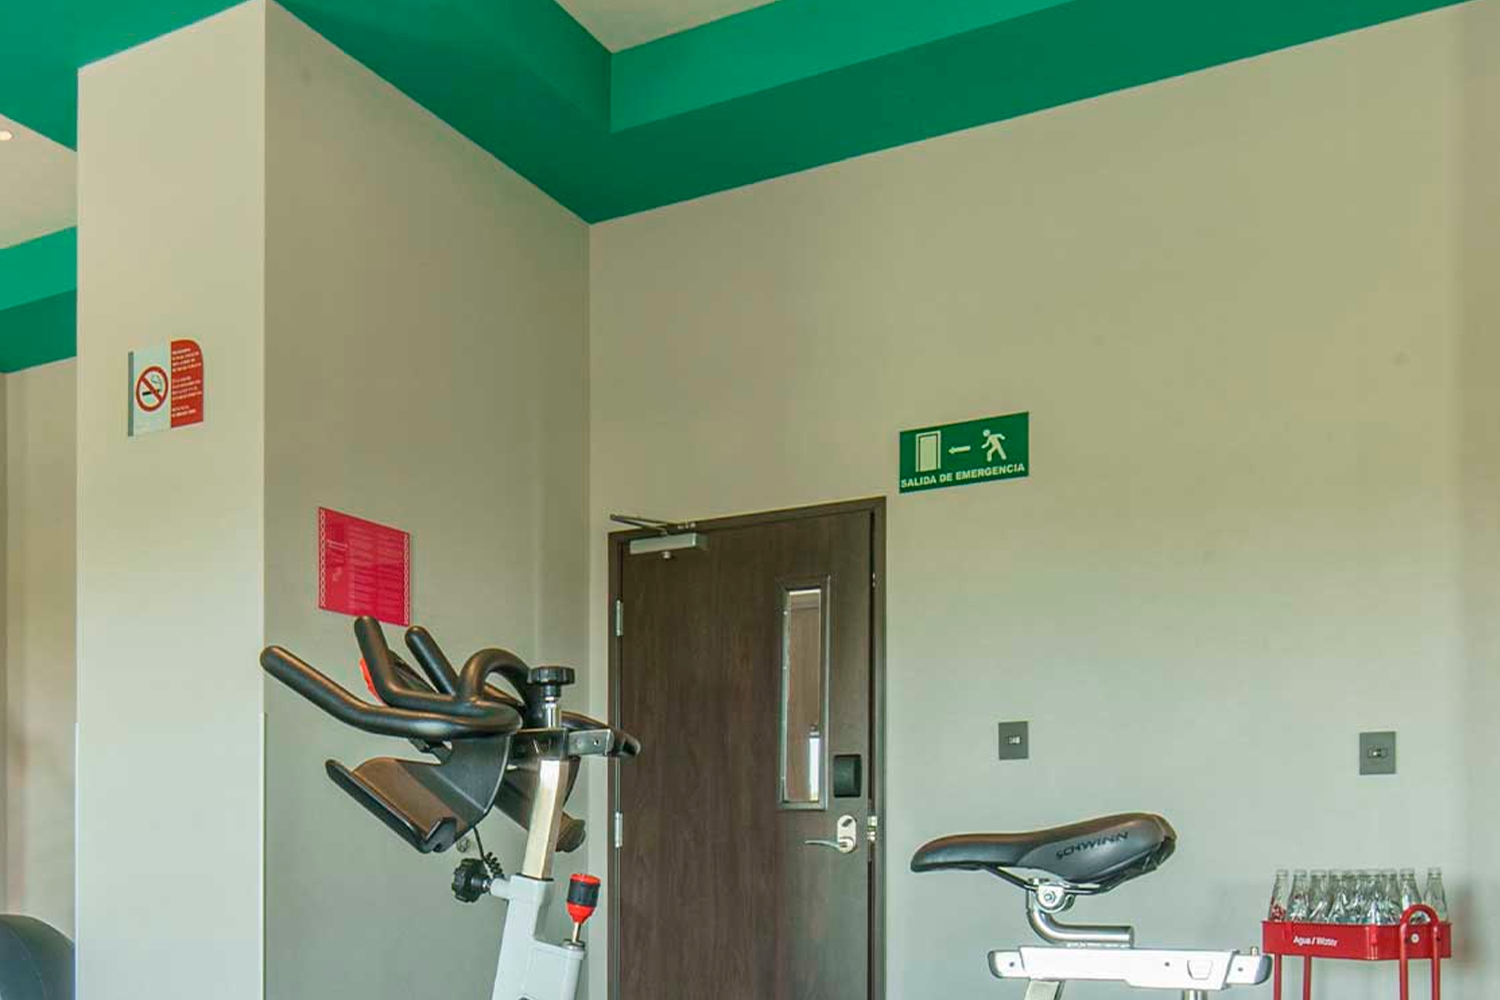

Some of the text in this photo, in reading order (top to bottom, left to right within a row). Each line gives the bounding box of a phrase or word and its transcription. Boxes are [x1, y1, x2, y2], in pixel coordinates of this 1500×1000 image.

[901, 463, 1025, 488] SALIDA DE EMERGENCIA
[1056, 831, 1128, 860] SCHWINN
